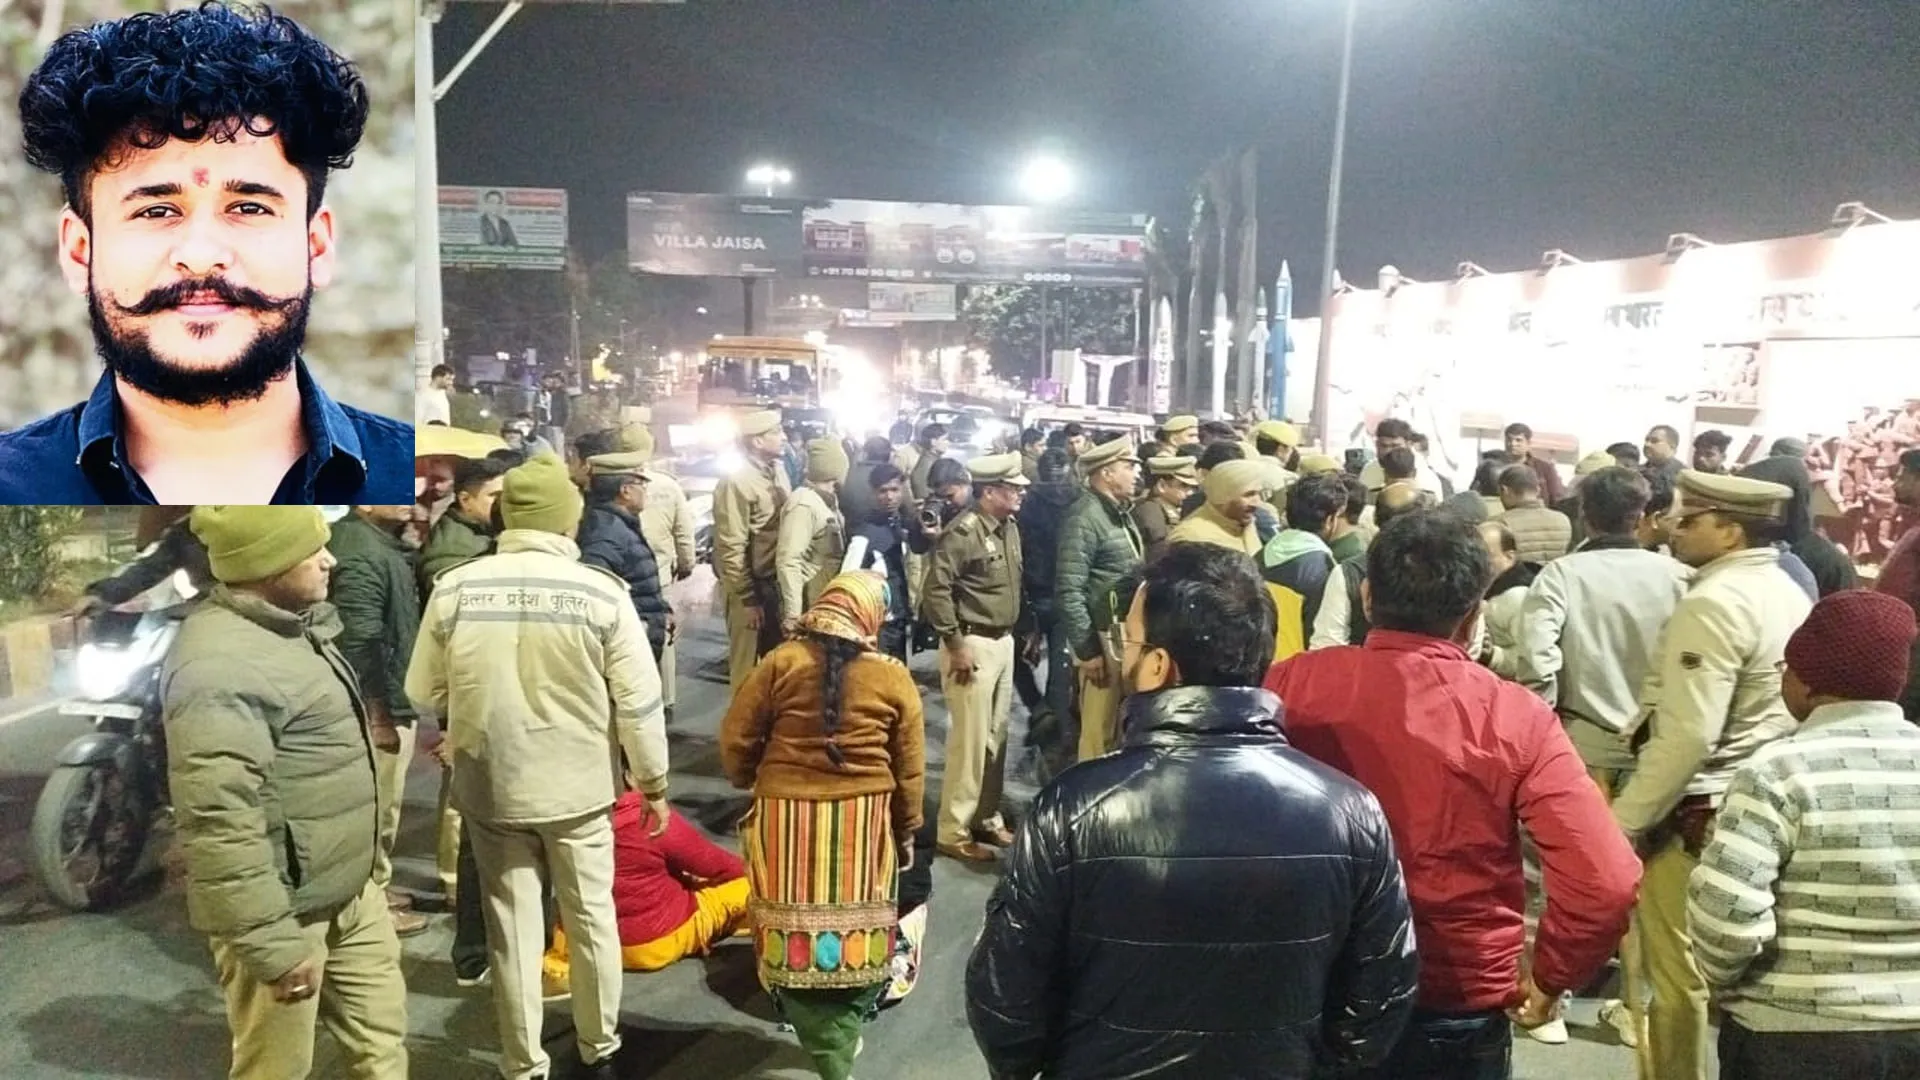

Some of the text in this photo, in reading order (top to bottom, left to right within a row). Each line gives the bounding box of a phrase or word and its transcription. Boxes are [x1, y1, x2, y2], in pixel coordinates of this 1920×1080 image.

[652, 233, 768, 250] VILLA JAISA
[460, 593, 496, 606] उत्तर
[506, 588, 540, 611] प्रदेश
